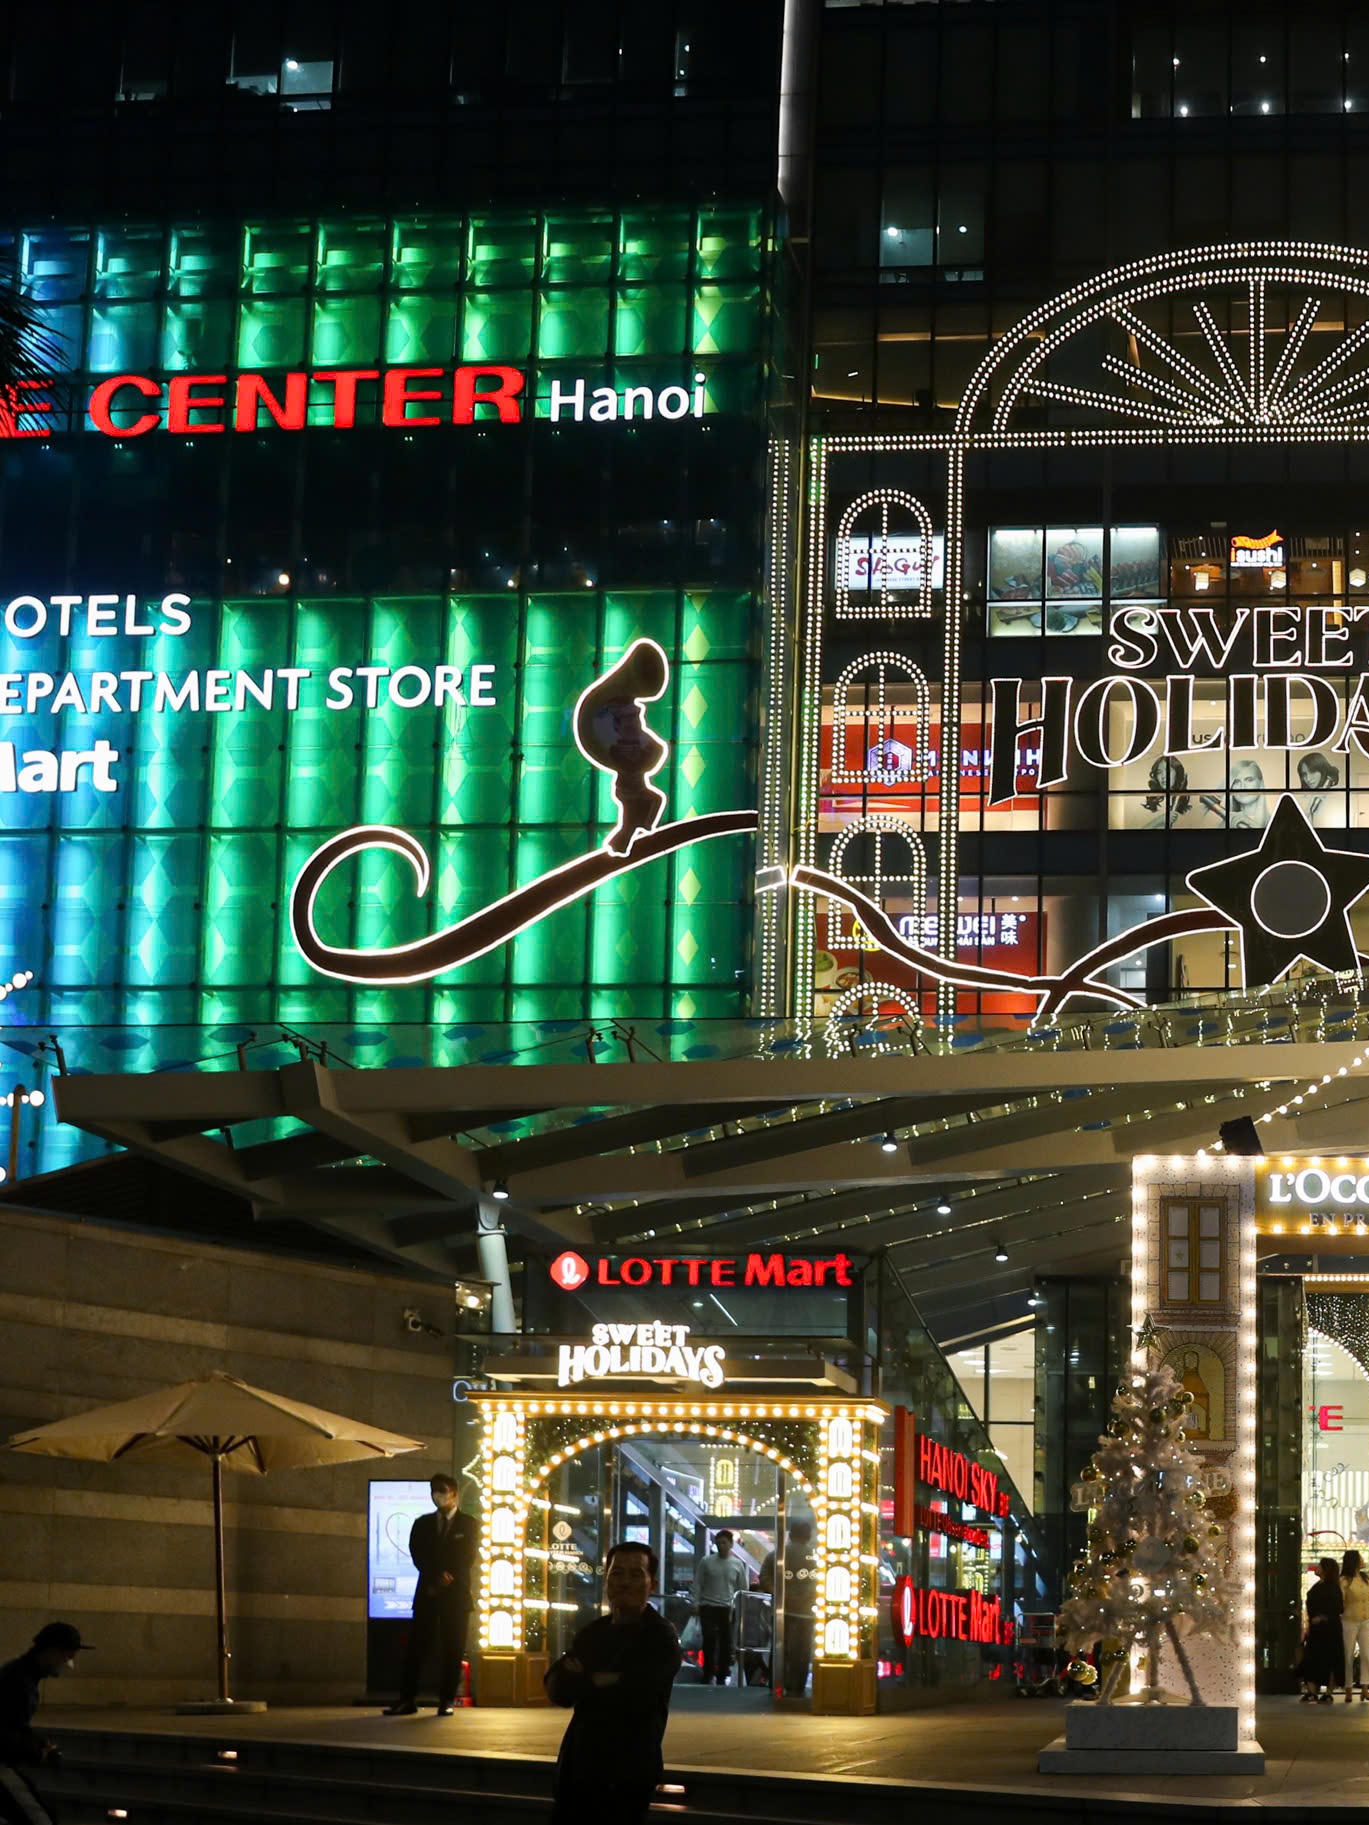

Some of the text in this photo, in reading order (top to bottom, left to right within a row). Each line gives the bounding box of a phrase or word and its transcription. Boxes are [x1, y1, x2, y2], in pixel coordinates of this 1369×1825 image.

[89, 366, 525, 438] CENTER
[550, 373, 707, 424] Hanoi
[4, 593, 193, 638] OTELS
[0, 664, 497, 715] EPARTMENT STORE
[1309, 1212, 1334, 1228] EN
[597, 1252, 853, 1287] LOTTE Mart
[591, 1321, 691, 1346] SWEET
[557, 1344, 726, 1389] HOLIDAYS
[920, 1433, 968, 1500] HANOI
[971, 1460, 999, 1514] SKY
[918, 1588, 968, 1640] LOTTE
[970, 1589, 1002, 1645] Mart
